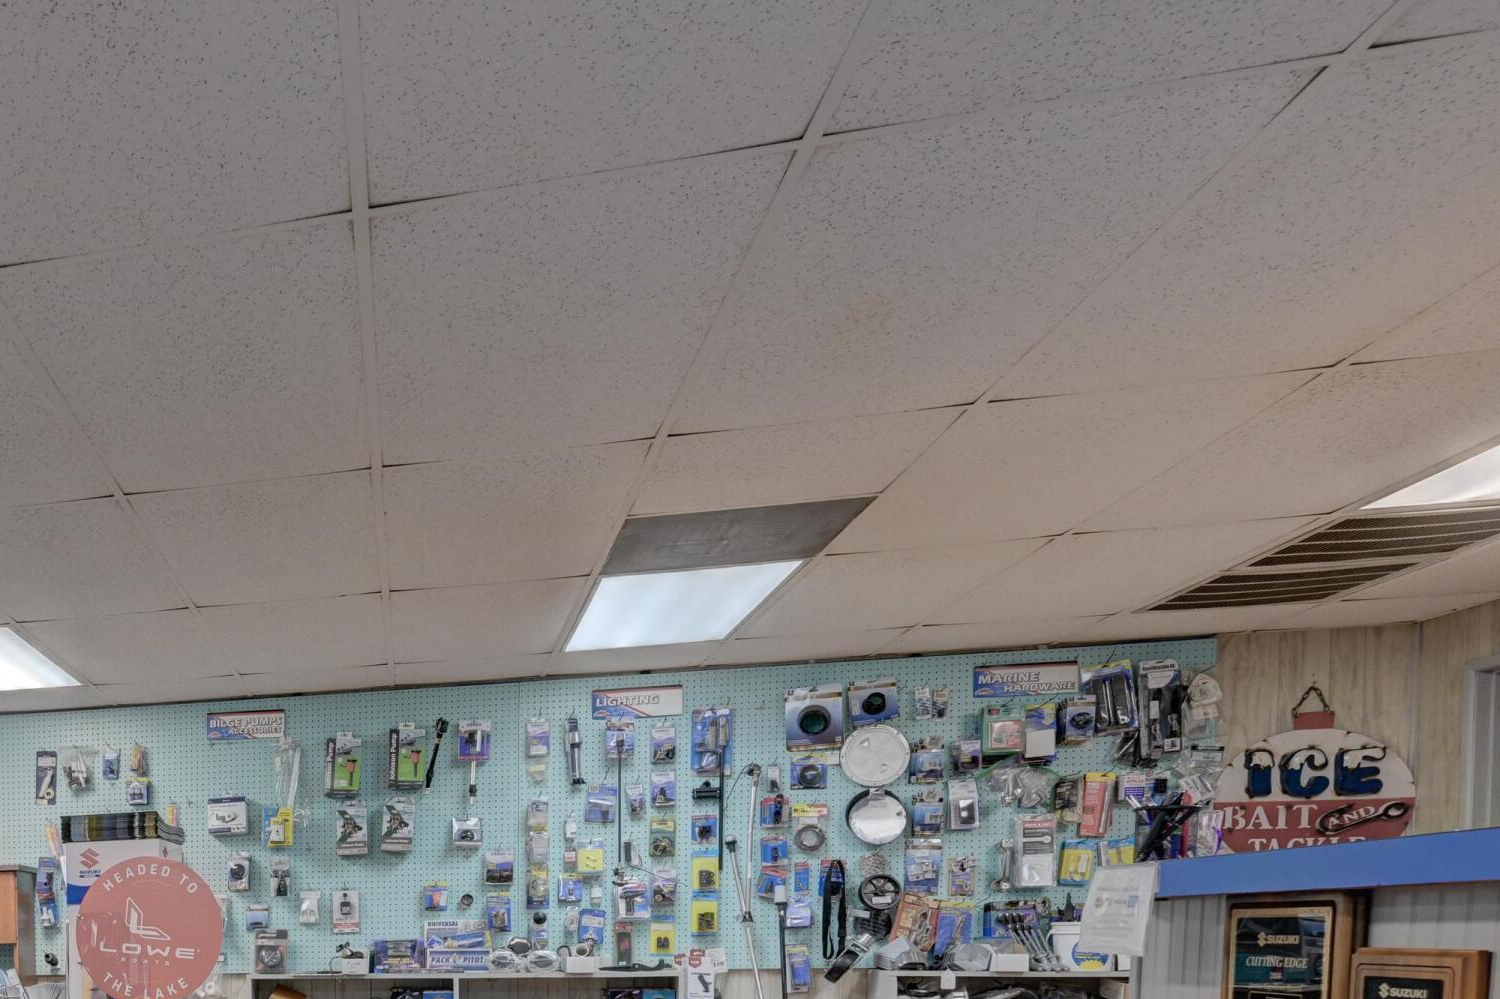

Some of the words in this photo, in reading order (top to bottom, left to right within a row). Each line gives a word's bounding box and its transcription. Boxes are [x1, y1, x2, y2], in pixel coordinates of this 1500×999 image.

[978, 671, 1041, 685] MARINE
[1004, 680, 1076, 693] HARDWARE
[596, 694, 660, 707] LIGHTING
[209, 718, 241, 729] BILGE
[243, 716, 283, 727] PUMPS
[228, 725, 283, 735] ACCESSORIES
[389, 755, 397, 781] Johnson
[1244, 746, 1387, 798] ICE
[1221, 804, 1318, 832] BAIT
[1327, 806, 1376, 828] AND
[102, 863, 171, 892] HEADED
[179, 874, 198, 894] TO
[1266, 934, 1300, 944] SUZUKI
[100, 941, 197, 960] LOWE
[430, 956, 450, 964] PACK
[1245, 955, 1283, 968] CUTTING
[1283, 957, 1309, 969] EDGE
[102, 972, 133, 997] THE
[144, 977, 188, 999] LAKE
[1389, 987, 1428, 999] SUZUKI
